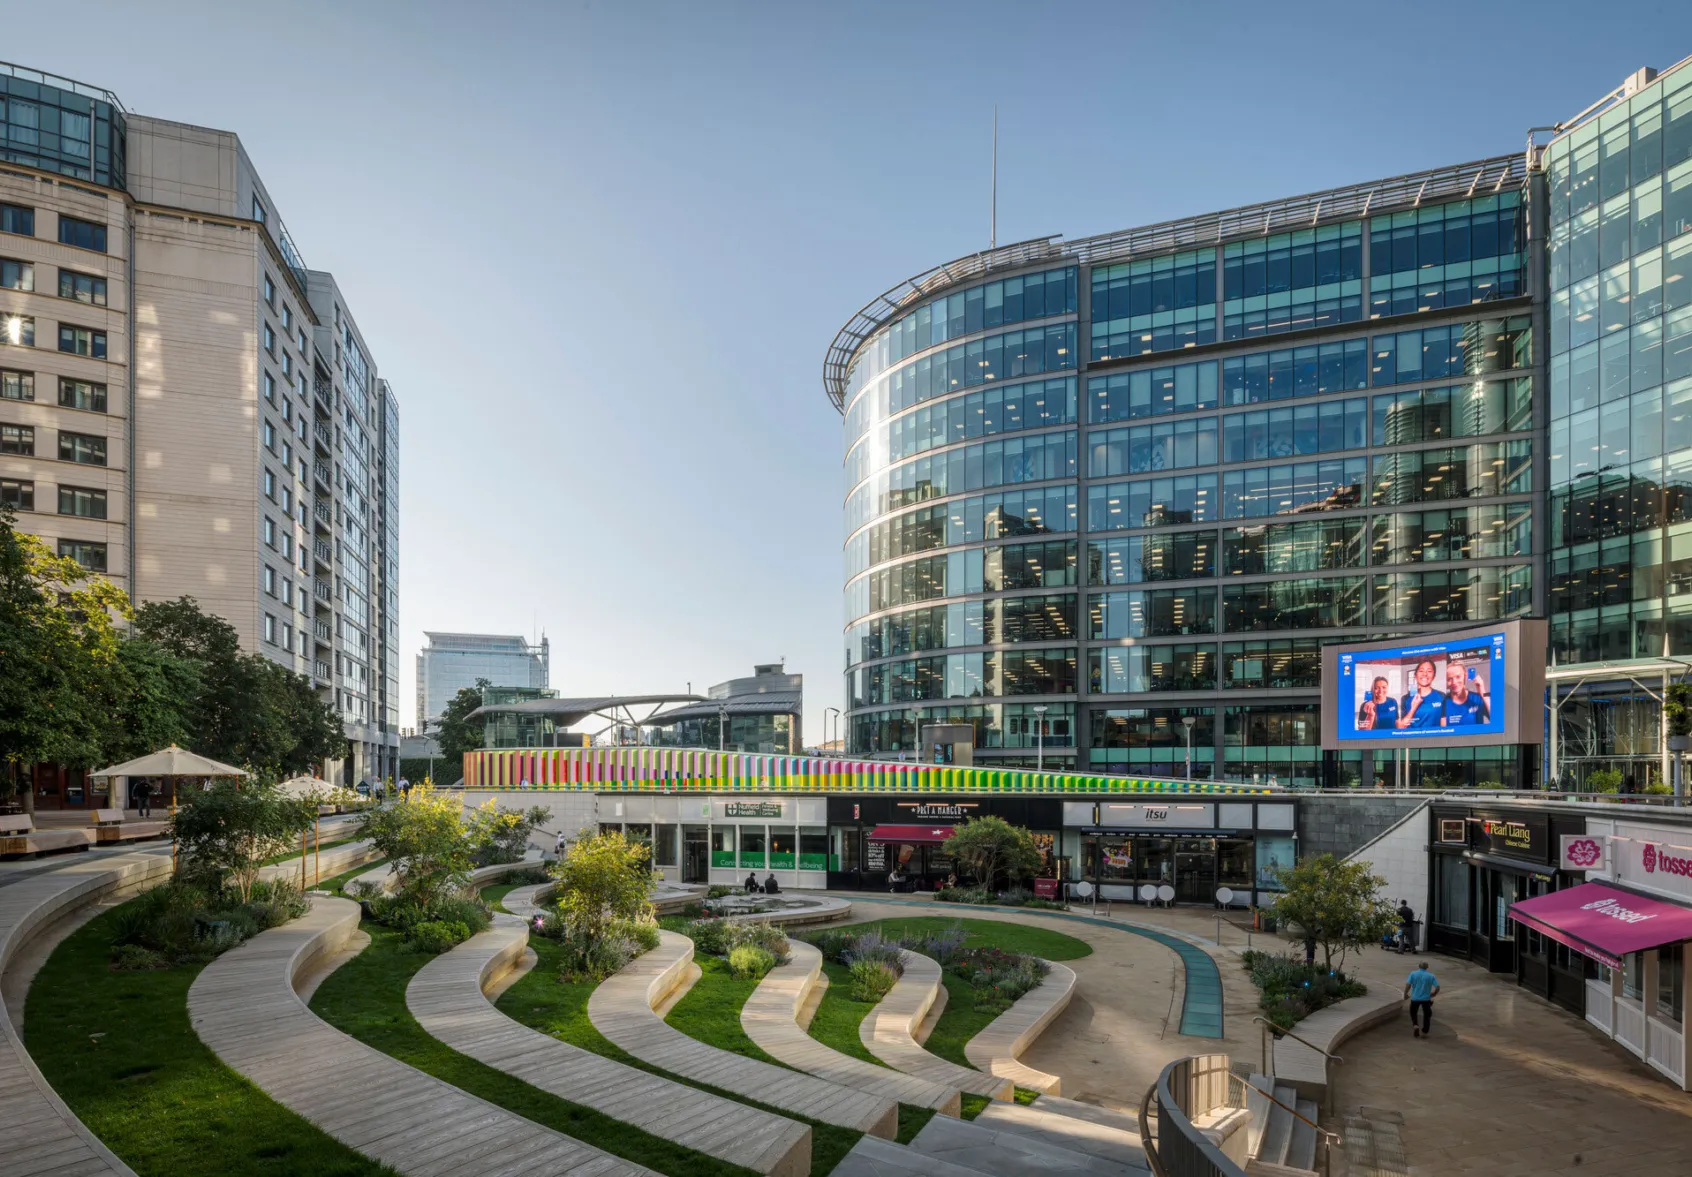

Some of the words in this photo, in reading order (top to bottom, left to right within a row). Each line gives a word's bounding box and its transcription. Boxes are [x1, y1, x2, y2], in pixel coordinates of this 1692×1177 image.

[917, 805, 930, 814] PRET
[932, 806, 936, 814] A
[938, 806, 962, 815] MANGER
[1146, 808, 1168, 820] itsu
[1490, 823, 1507, 836] Pearl
[1509, 825, 1530, 842] Liang
[1658, 850, 1692, 878] tosse
[1596, 904, 1658, 924] tossed
